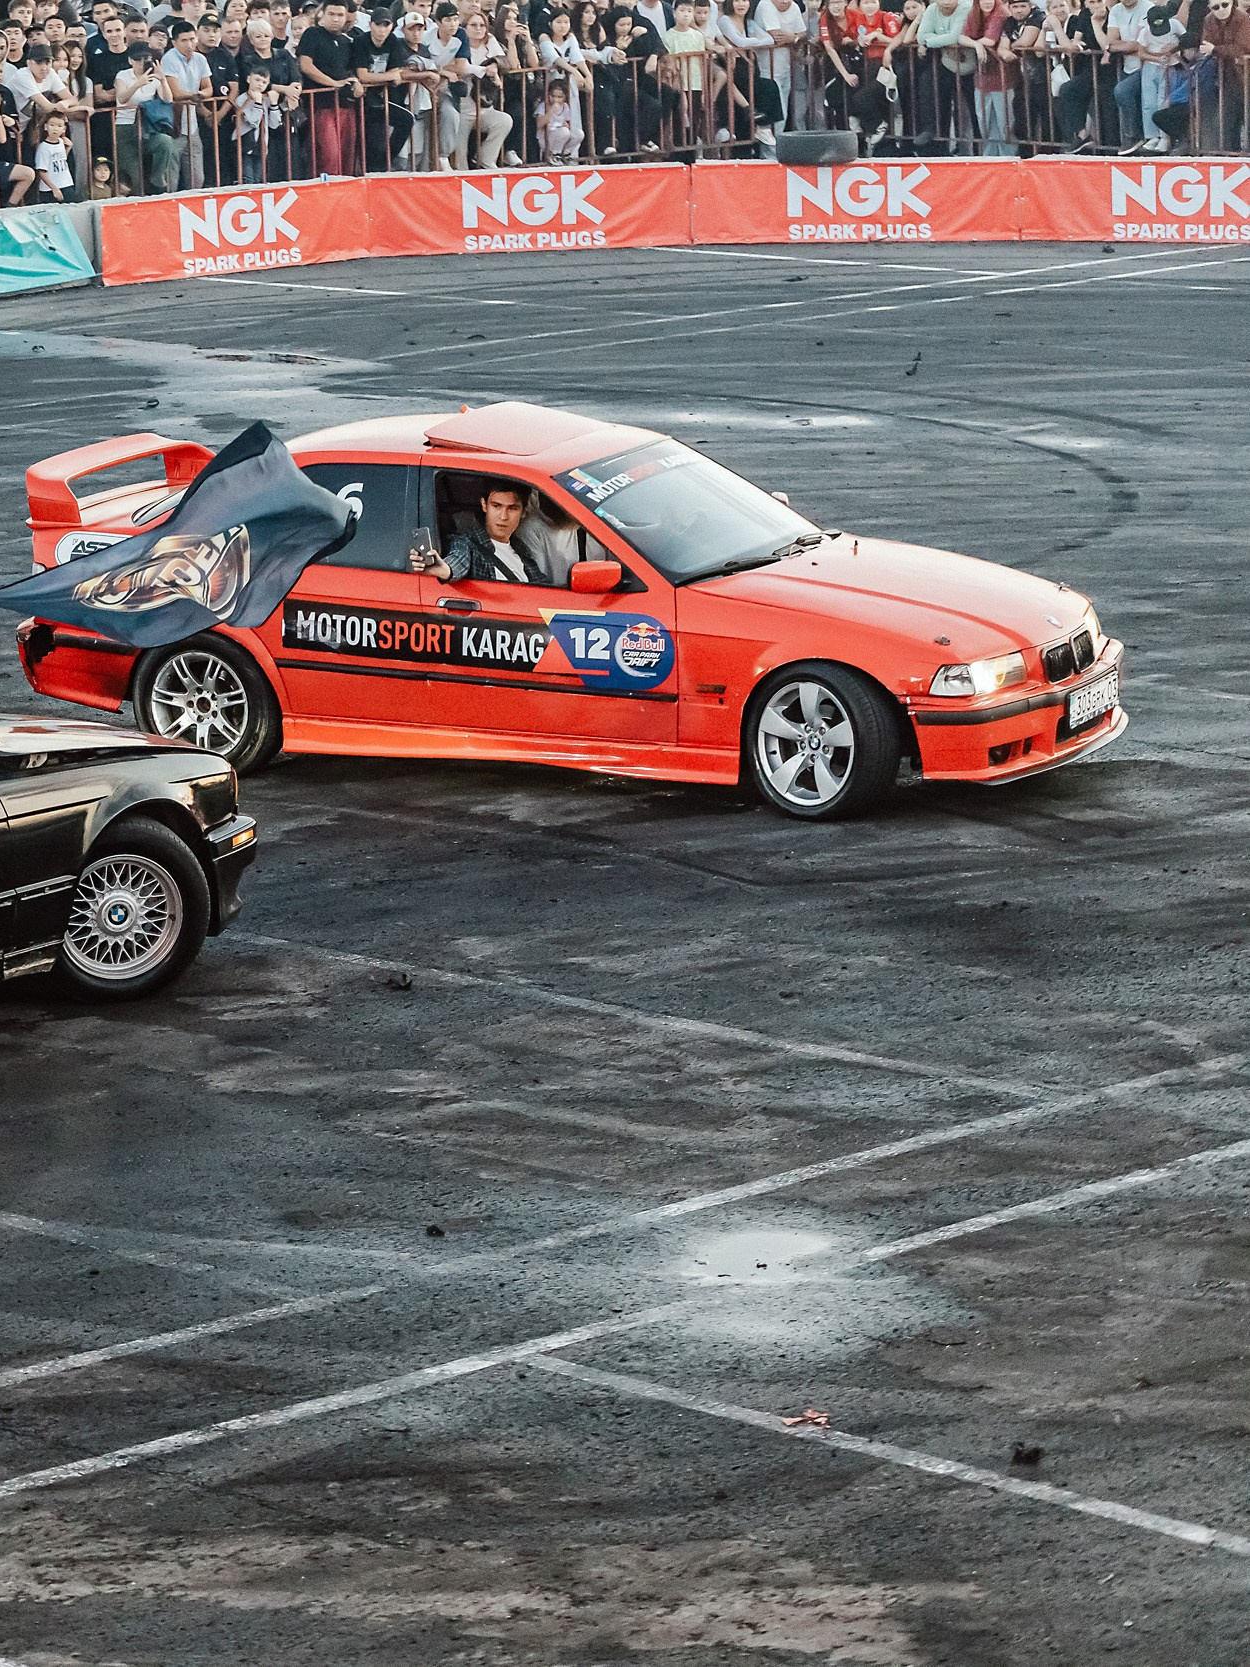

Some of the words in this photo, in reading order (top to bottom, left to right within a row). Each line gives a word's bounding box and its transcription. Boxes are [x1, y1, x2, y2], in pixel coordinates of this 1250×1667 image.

[462, 170, 607, 228] NGK
[787, 163, 933, 218] NGK
[1111, 164, 1250, 219] NGK
[179, 187, 300, 253] NGK
[788, 223, 857, 240] SPARK
[862, 223, 933, 240] PLUGS
[1113, 223, 1180, 239] SPARK
[1184, 223, 1250, 240] PLUGS
[465, 232, 535, 250] SPARK
[537, 230, 607, 248] PLUGS
[184, 256, 241, 276] SPARK
[243, 248, 302, 270] PLUGS
[296, 610, 456, 655] MOTORSPORT
[461, 626, 554, 663] KARAG
[569, 627, 610, 660] 12
[622, 638, 642, 650] Red
[643, 638, 665, 652] Bull
[623, 657, 661, 668] DRIFT
